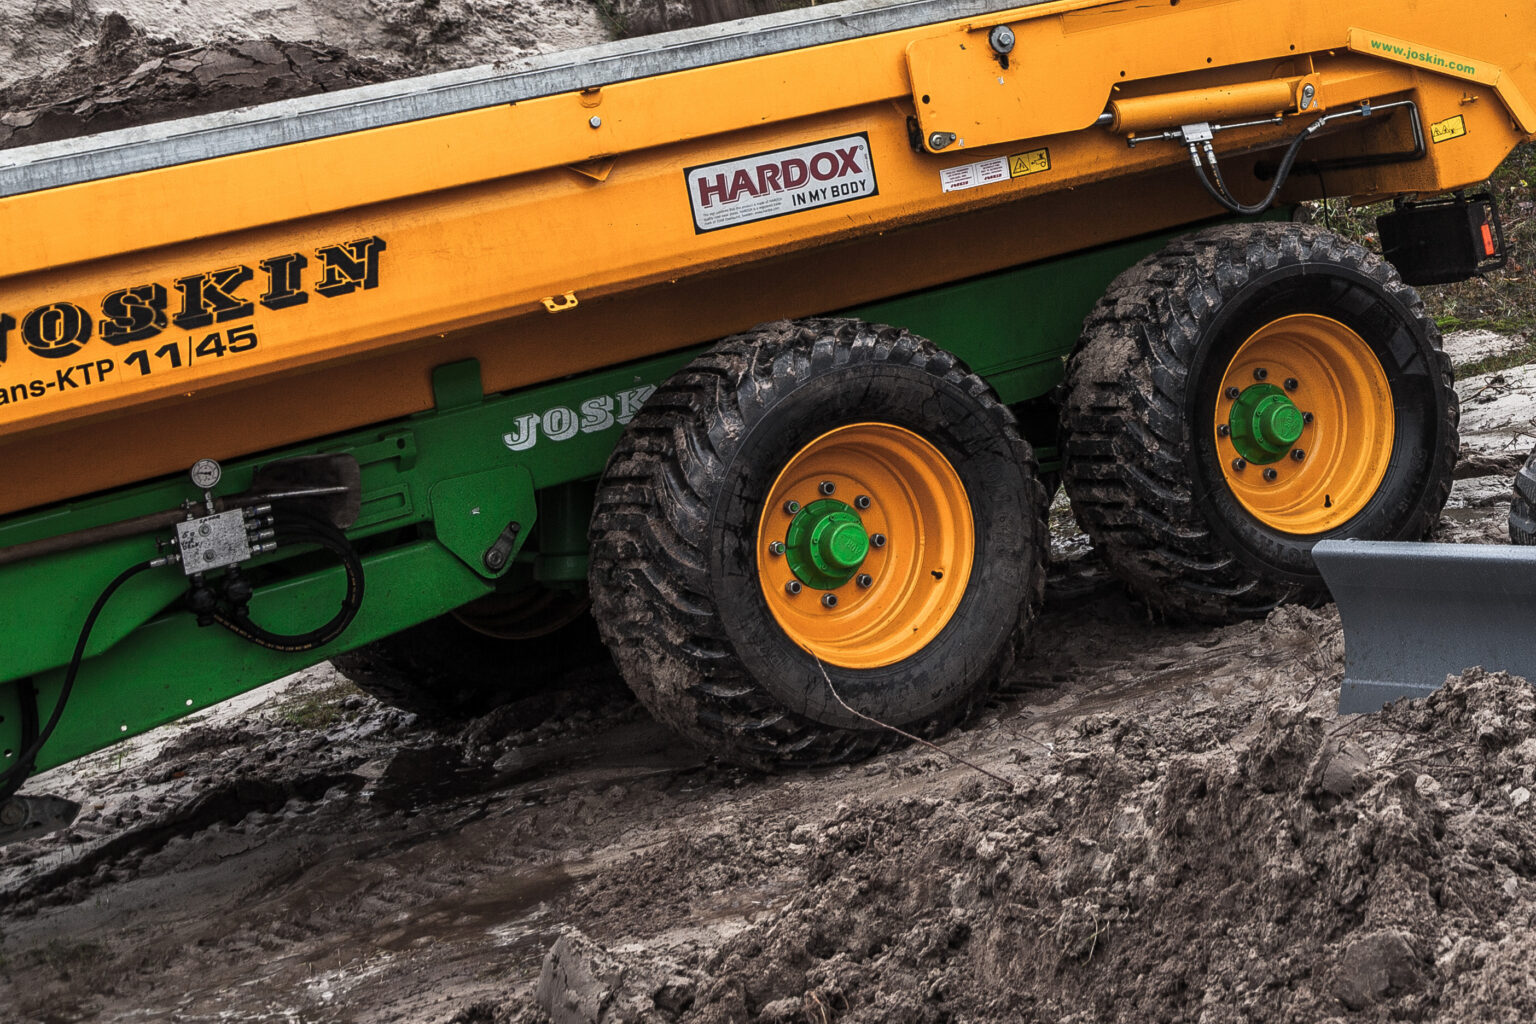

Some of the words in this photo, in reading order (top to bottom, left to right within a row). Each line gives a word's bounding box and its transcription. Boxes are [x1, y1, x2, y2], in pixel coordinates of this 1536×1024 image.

[1370, 39, 1476, 75] www.joskin.com
[791, 193, 807, 206] IN
[809, 186, 827, 204] MY
[830, 179, 867, 198] BODY
[0, 235, 386, 363] OSKIN
[123, 324, 259, 376] 11/45
